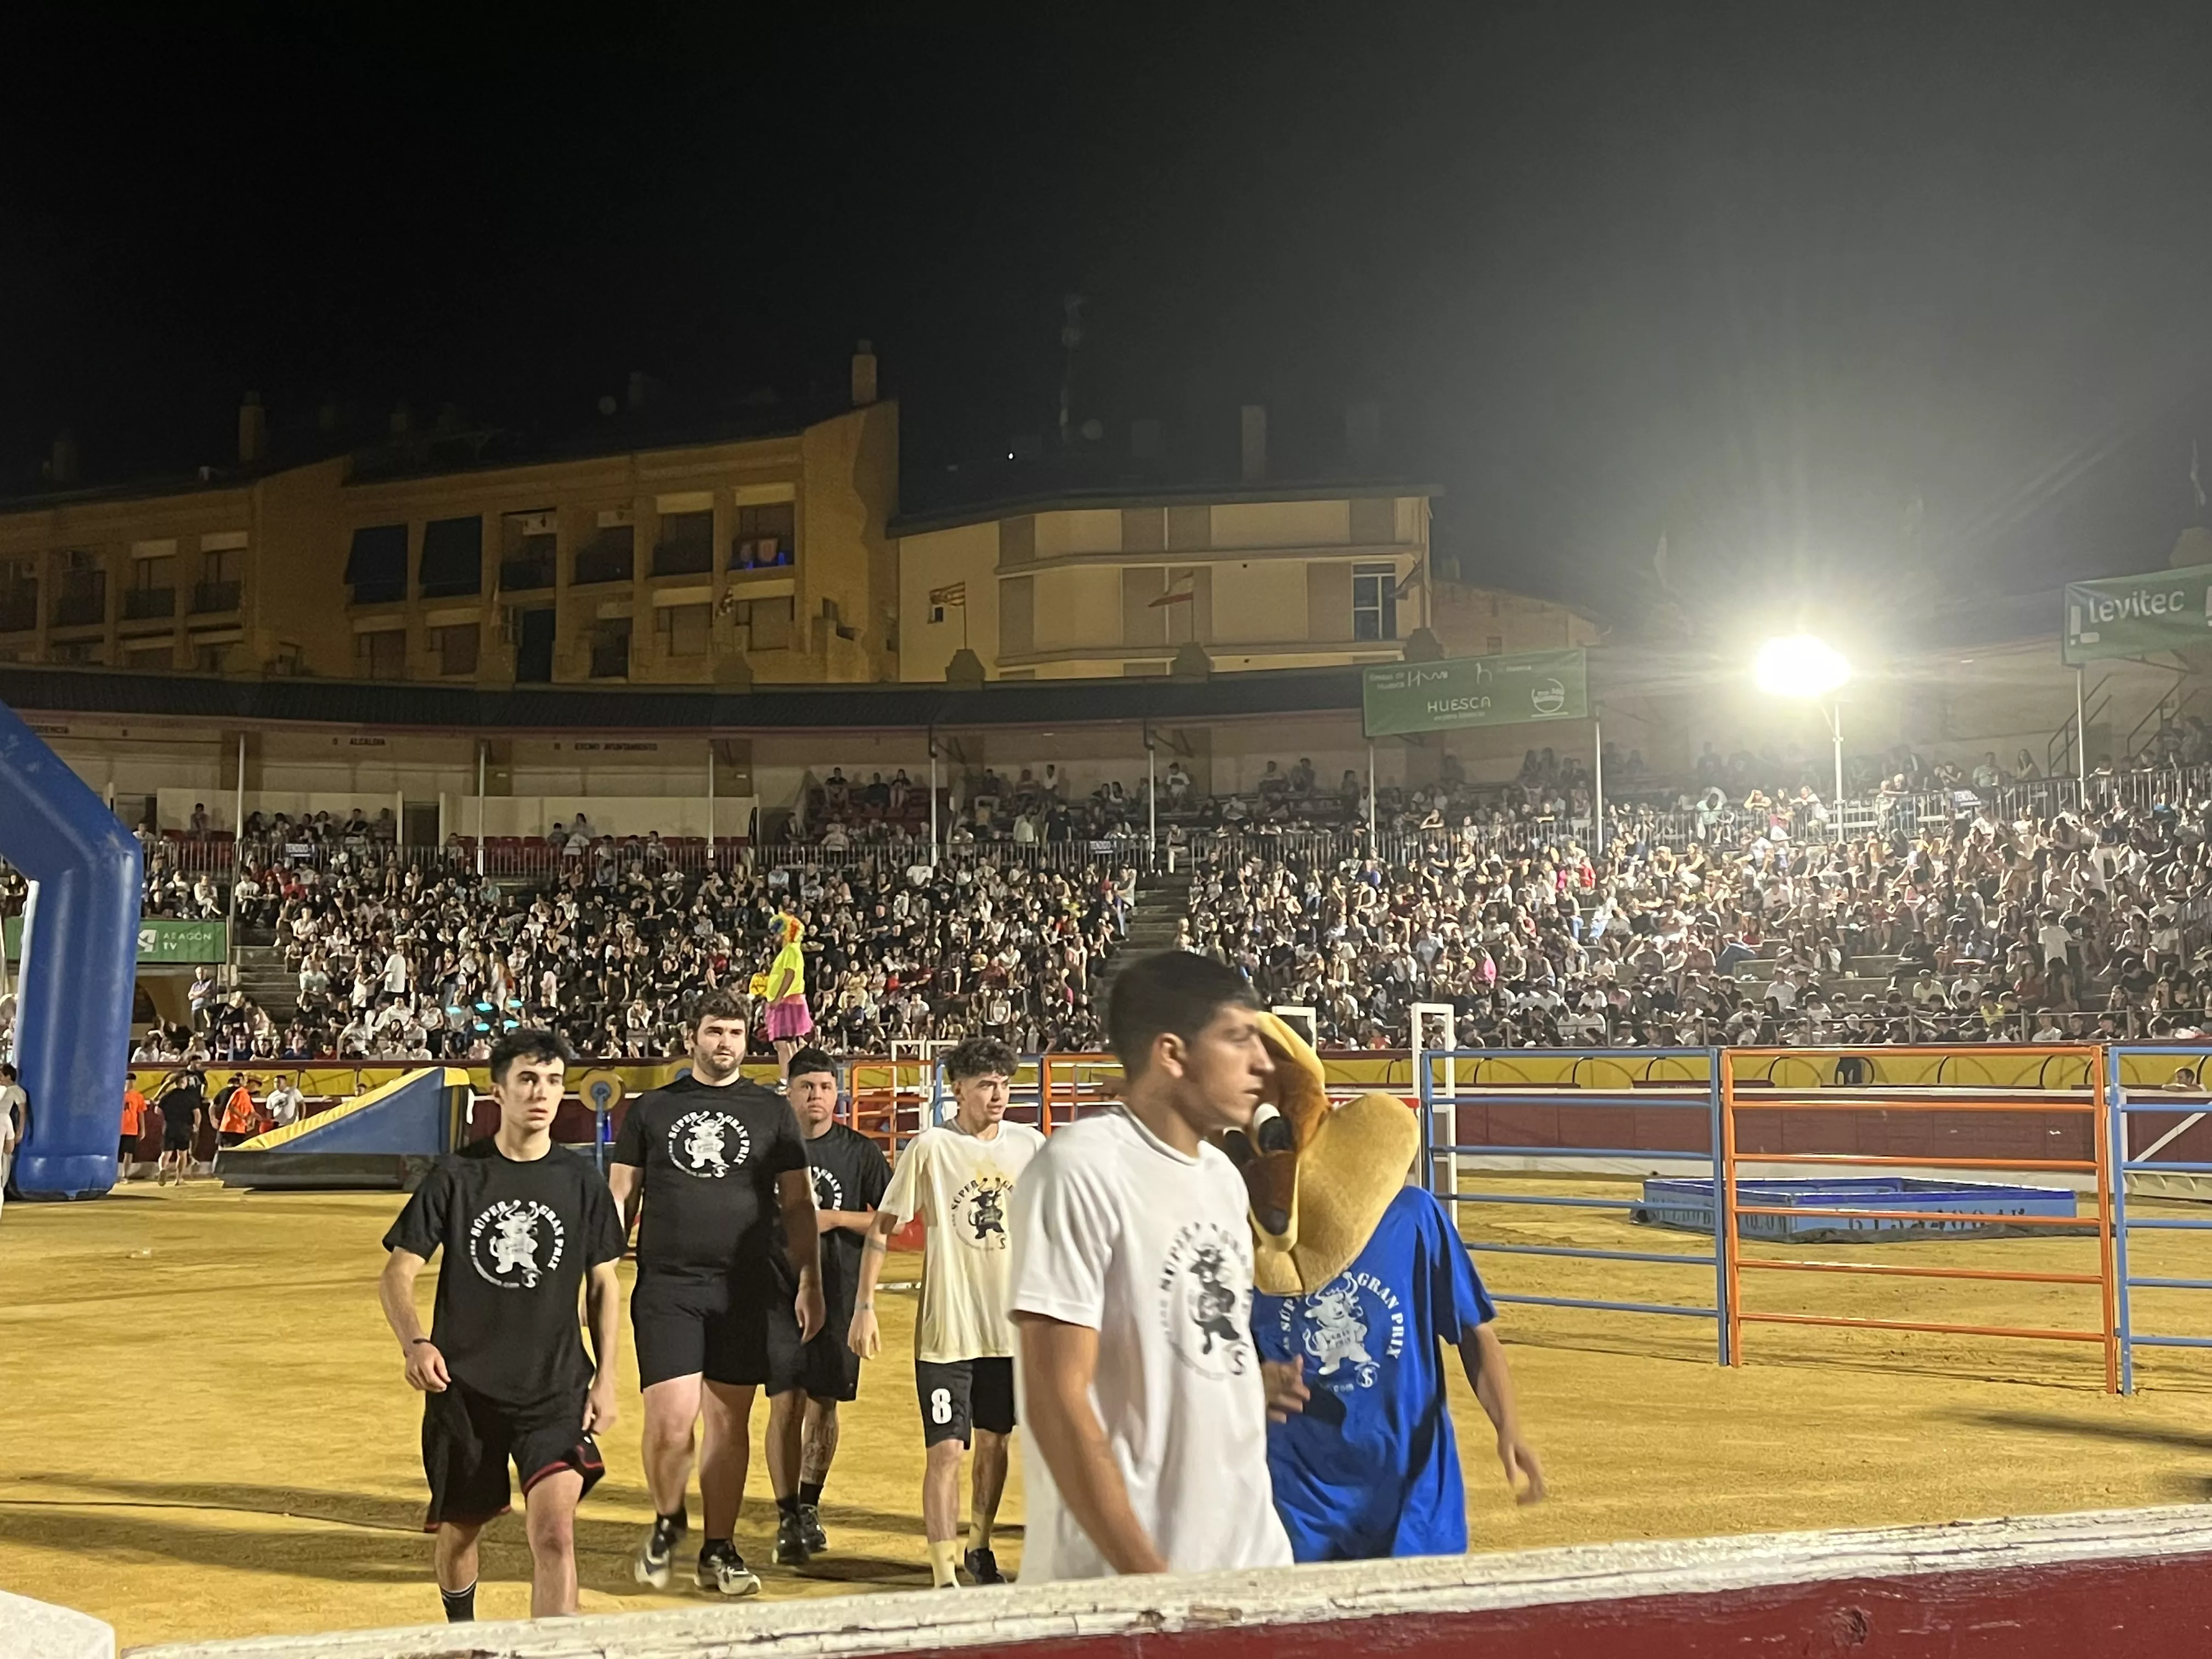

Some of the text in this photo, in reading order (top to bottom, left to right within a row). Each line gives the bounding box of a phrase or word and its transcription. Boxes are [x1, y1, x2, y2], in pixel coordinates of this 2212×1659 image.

[1427, 696, 1491, 713] HUESCA
[163, 942, 177, 950] TV
[1357, 1272, 1399, 1310] GRAN
[1386, 1312, 1404, 1359] PRIX
[931, 1388, 952, 1424] 8
